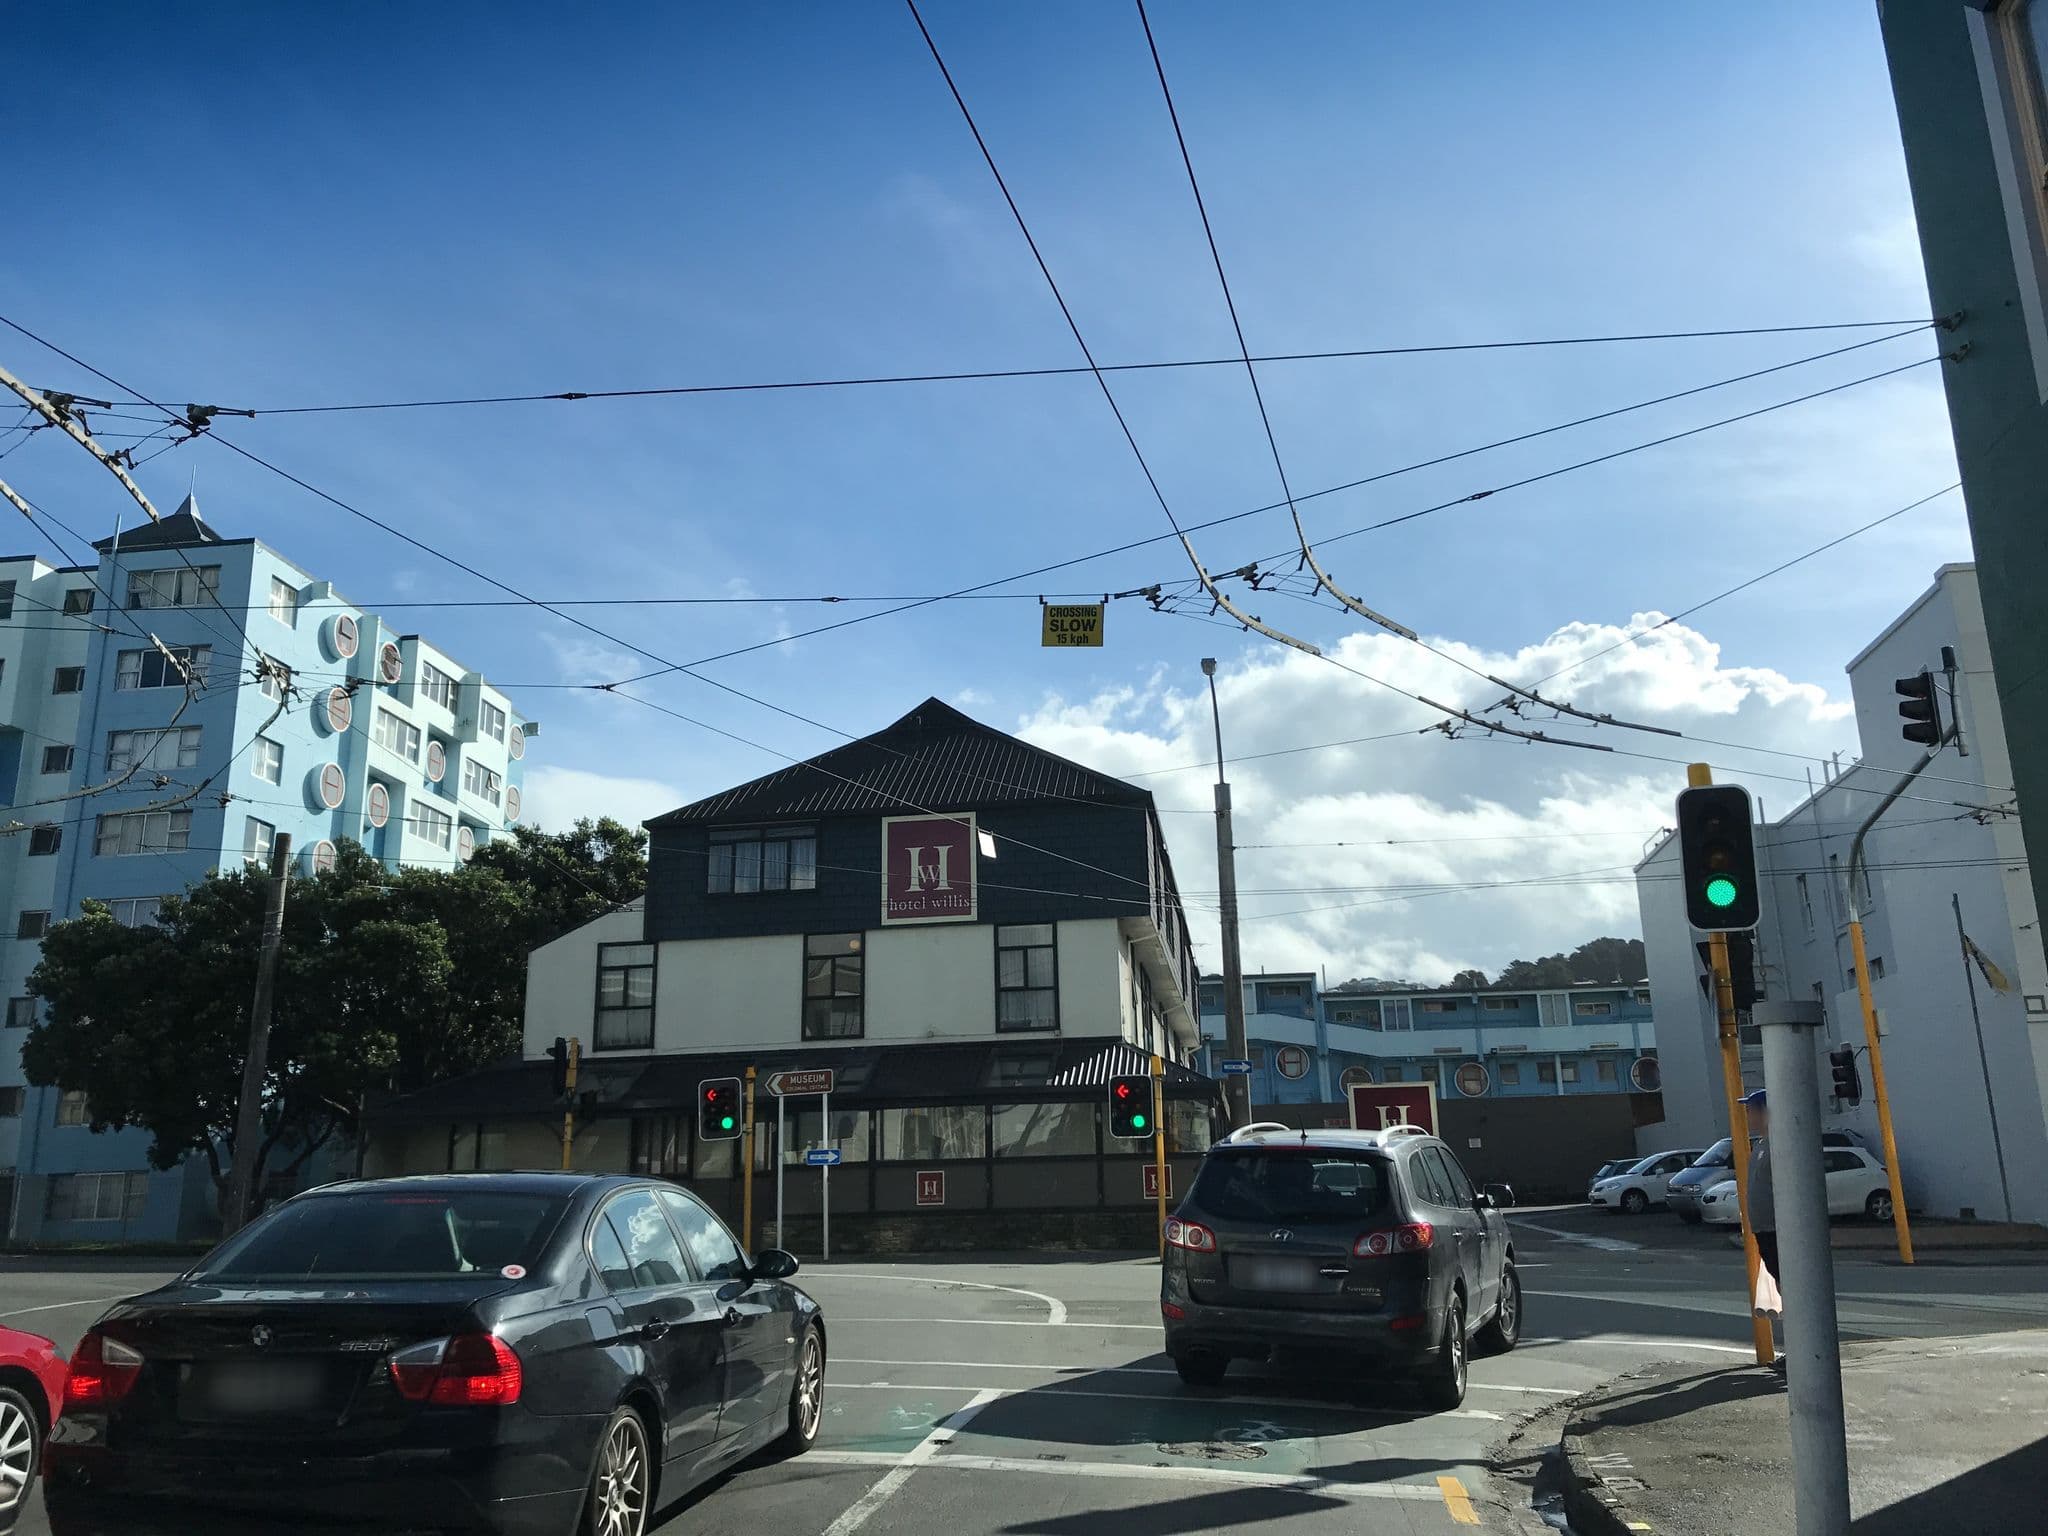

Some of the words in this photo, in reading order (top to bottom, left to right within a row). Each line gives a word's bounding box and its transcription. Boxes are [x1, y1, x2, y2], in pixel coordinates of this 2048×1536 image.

[1049, 607, 1097, 618] CROSSING
[1049, 619, 1097, 632] SLOW
[1056, 633, 1067, 644] 15
[1070, 633, 1089, 646] kph
[889, 896, 926, 911] hotel
[931, 894, 970, 908] willis
[790, 1073, 825, 1084] MUSEUM
